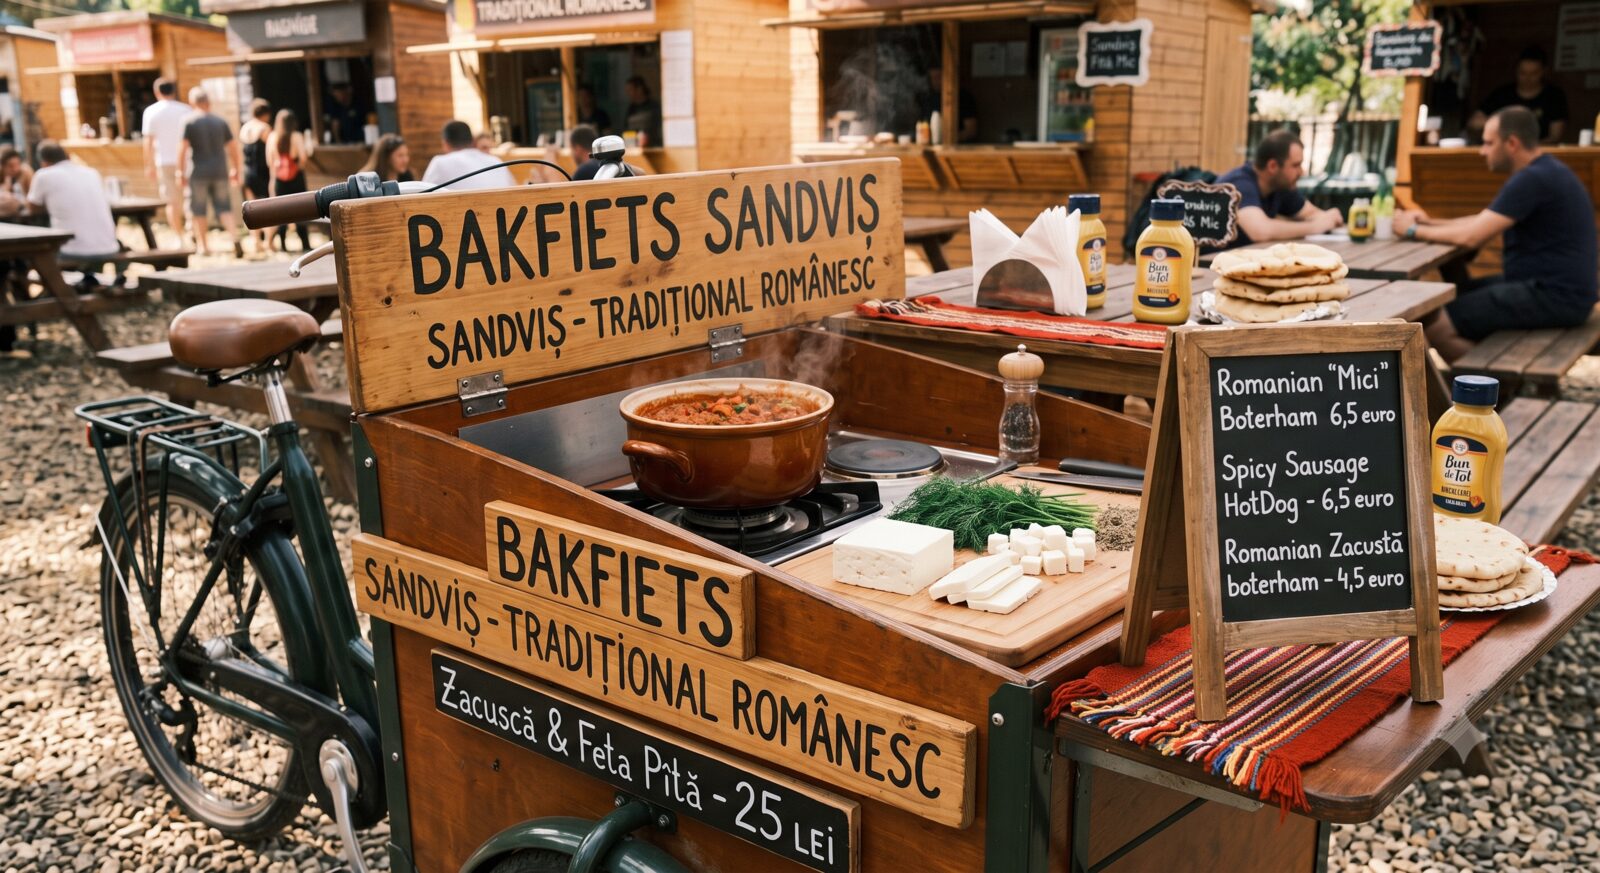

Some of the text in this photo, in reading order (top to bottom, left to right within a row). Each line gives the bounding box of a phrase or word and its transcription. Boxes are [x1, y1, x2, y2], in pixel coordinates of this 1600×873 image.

[408, 172, 881, 295] BAKFIETS SANDVIȘ
[1149, 262, 1168, 273] Bun
[427, 304, 566, 370] SANDVIȘ
[590, 276, 754, 339] TRADIȚIONAL
[761, 252, 876, 308] ROMÂNESC
[1217, 368, 1323, 396] Romanian
[1220, 402, 1396, 431] Boterham 6,5 euro
[1222, 451, 1369, 488] Spicy Sausage
[1444, 469, 1455, 479] de
[1445, 454, 1470, 468] Bun
[1224, 490, 1298, 524] HotDog
[1321, 487, 1350, 513] 6,5
[1355, 492, 1394, 508] euro
[1225, 538, 1322, 565] Romanian
[497, 516, 733, 647] BAKFIETS
[1227, 570, 1318, 597] boterham
[1337, 566, 1364, 593] 4,5
[1368, 572, 1404, 587] euro
[440, 665, 538, 744] Zacuscă
[547, 707, 568, 757] &
[578, 719, 633, 782] Feta
[735, 781, 782, 841] 25
[732, 679, 941, 799] ROMÂNESC
